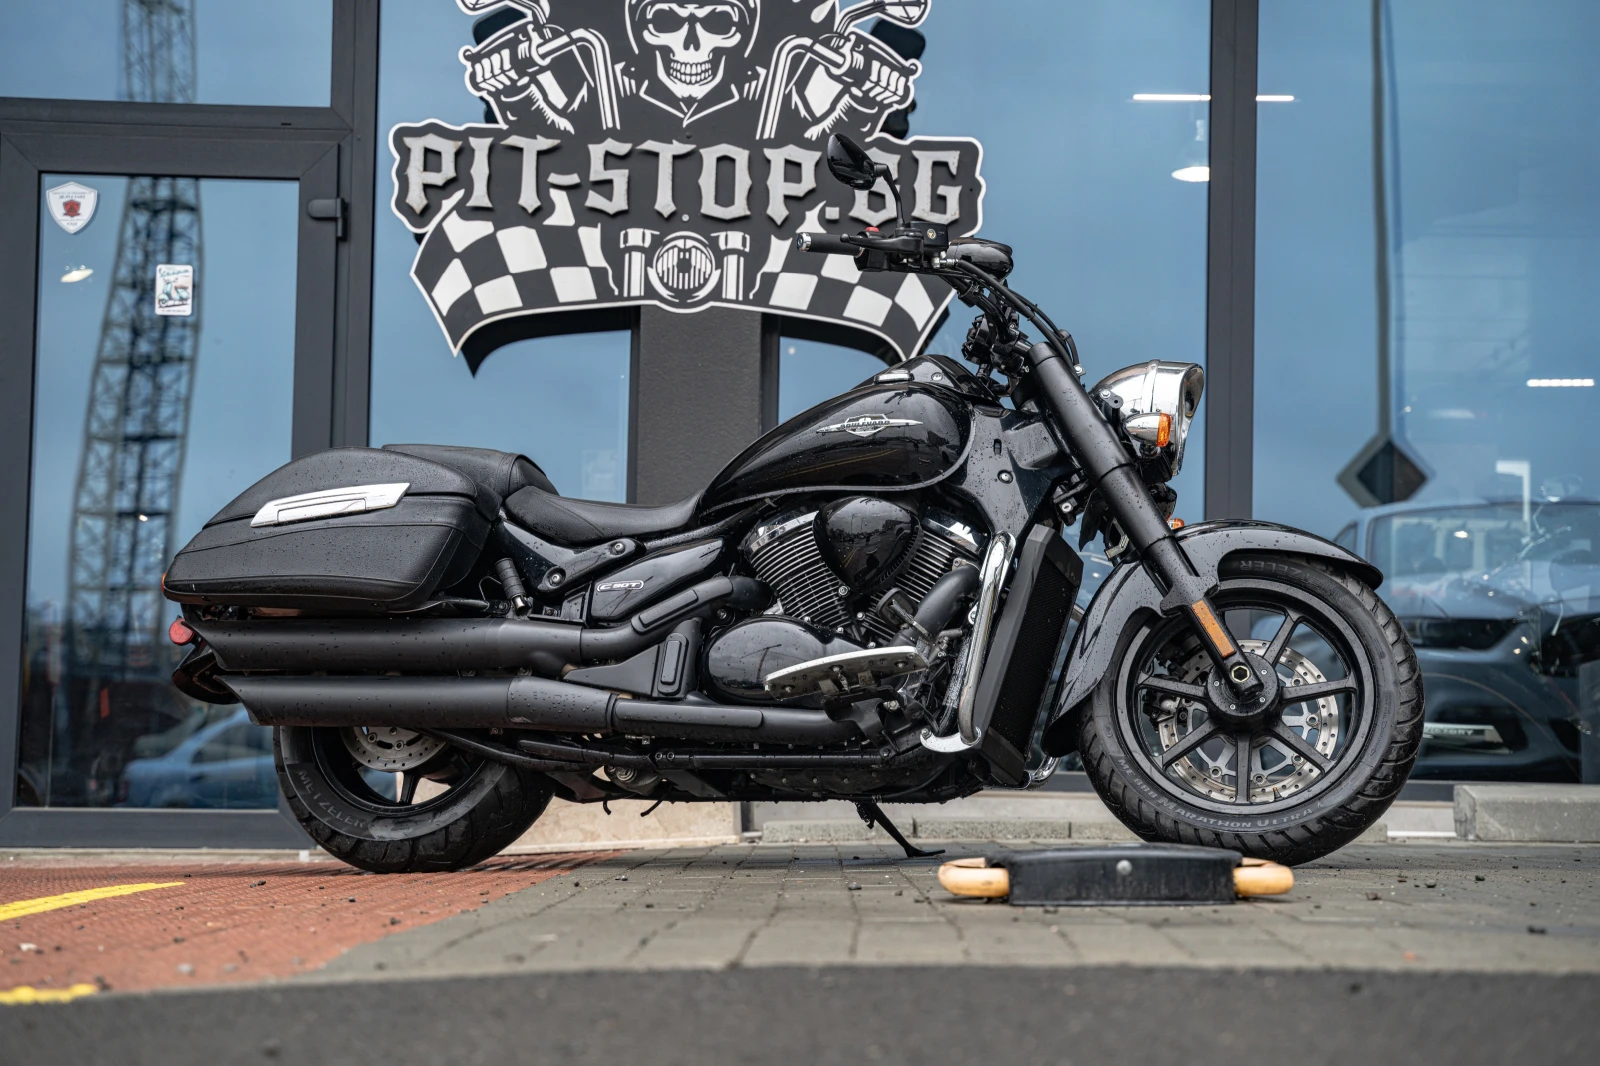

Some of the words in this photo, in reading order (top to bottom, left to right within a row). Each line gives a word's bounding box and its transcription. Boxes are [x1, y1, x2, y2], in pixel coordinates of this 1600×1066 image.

[298, 771, 367, 828] METZELER
[1118, 759, 1136, 777] ME
[1158, 797, 1252, 828] MARATHON
[1257, 808, 1314, 828] ULTRA
